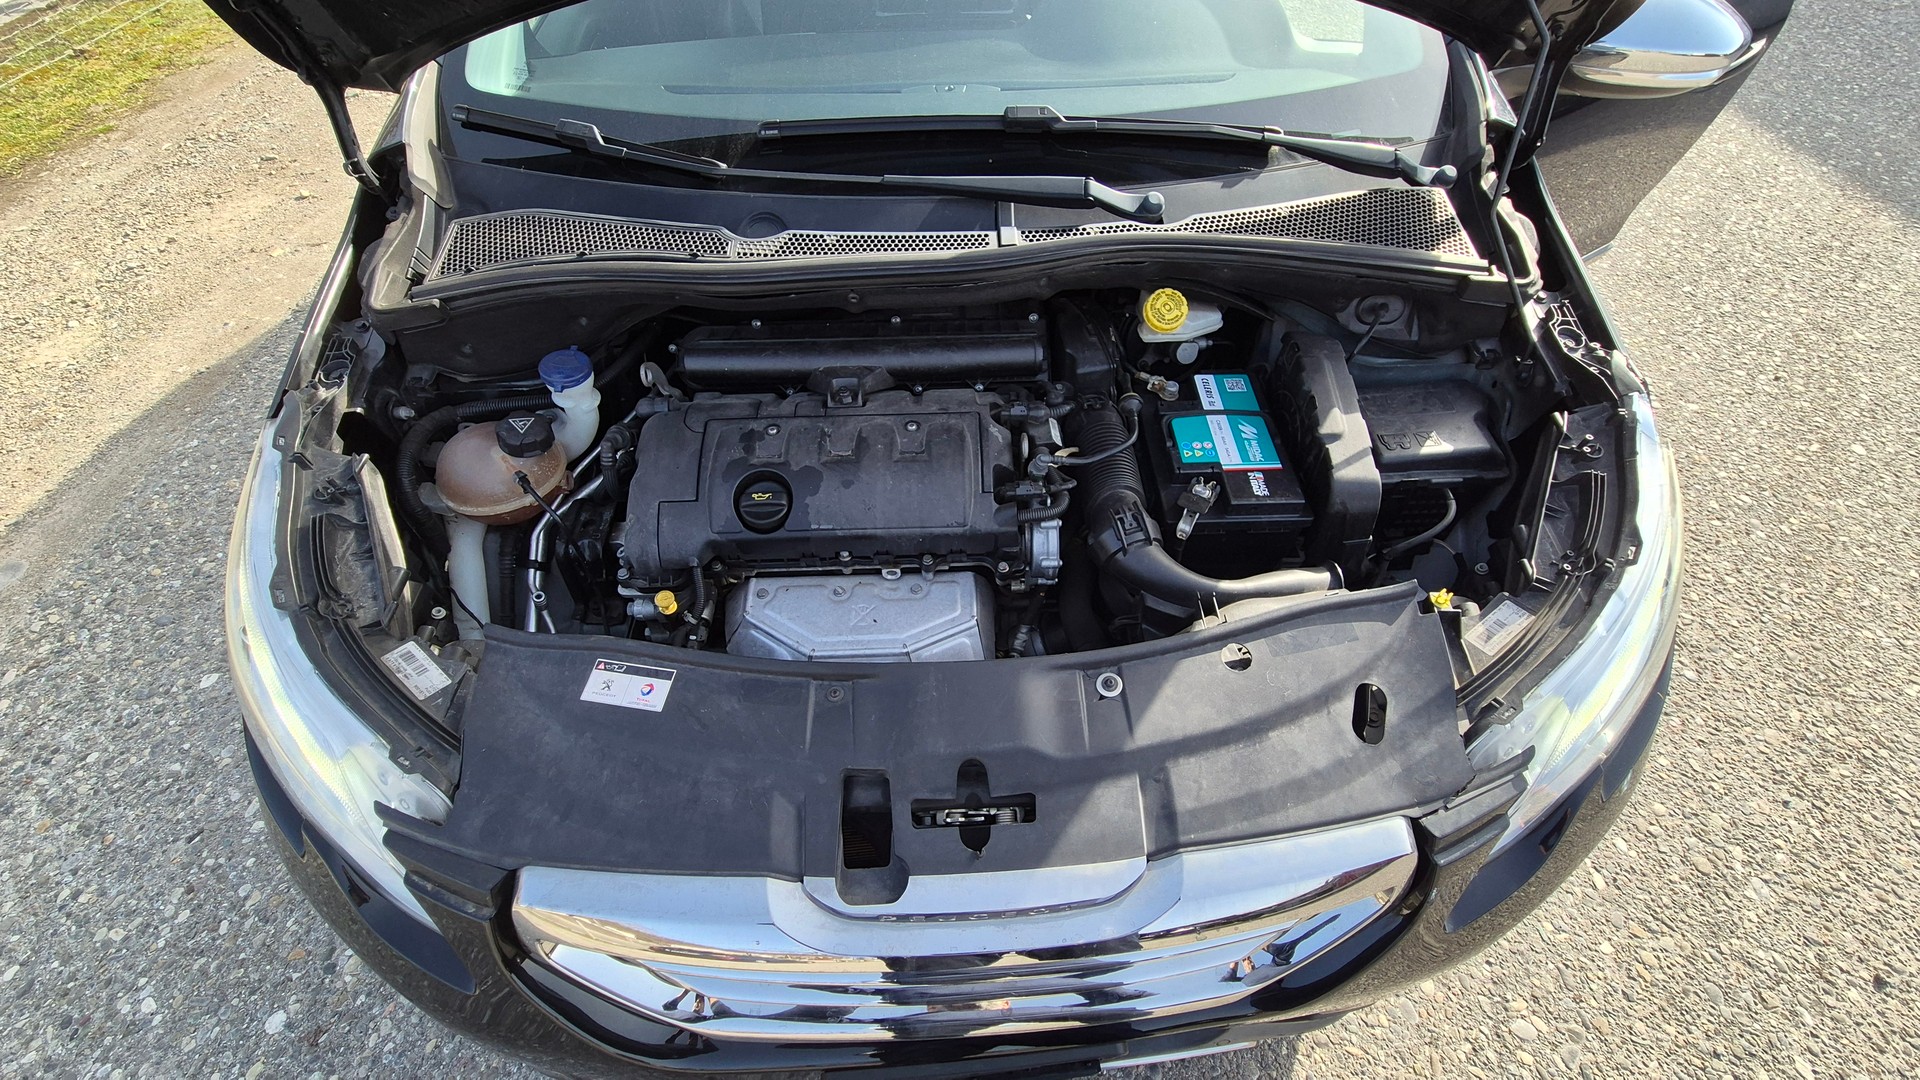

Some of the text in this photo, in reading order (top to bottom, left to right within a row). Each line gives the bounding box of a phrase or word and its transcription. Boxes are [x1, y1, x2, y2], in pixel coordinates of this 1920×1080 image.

[1201, 378, 1214, 399] CELERIS
[1250, 440, 1264, 462] MIDAC
[1250, 480, 1263, 496] ITALY
[1259, 480, 1270, 496] MADE
